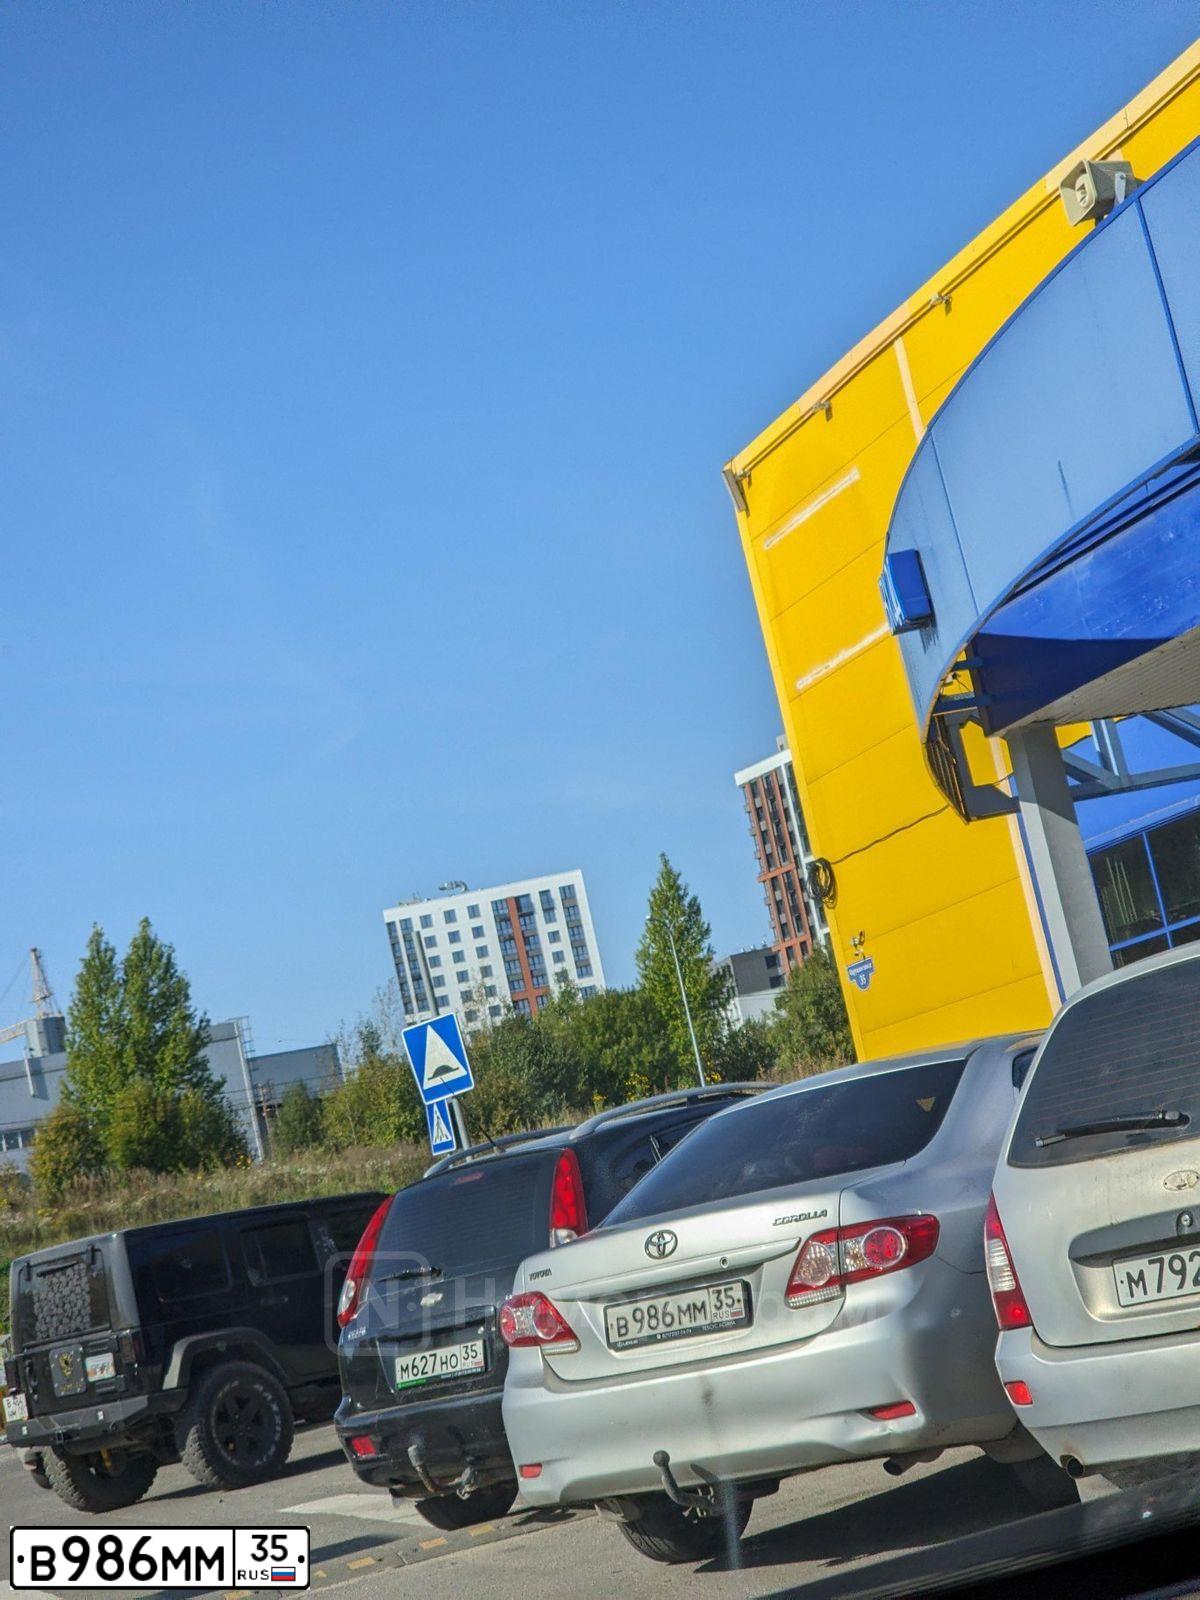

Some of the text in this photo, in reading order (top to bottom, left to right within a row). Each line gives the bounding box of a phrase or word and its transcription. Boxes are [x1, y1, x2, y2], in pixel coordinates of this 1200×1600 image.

[772, 1209, 828, 1226] COROLLA
[529, 1268, 552, 1281] TOYOTA
[616, 1287, 736, 1337] В986ММ 35
[712, 1311, 730, 1320] RUS
[400, 1353, 459, 1380] М627НО
[463, 1344, 478, 1361] 35
